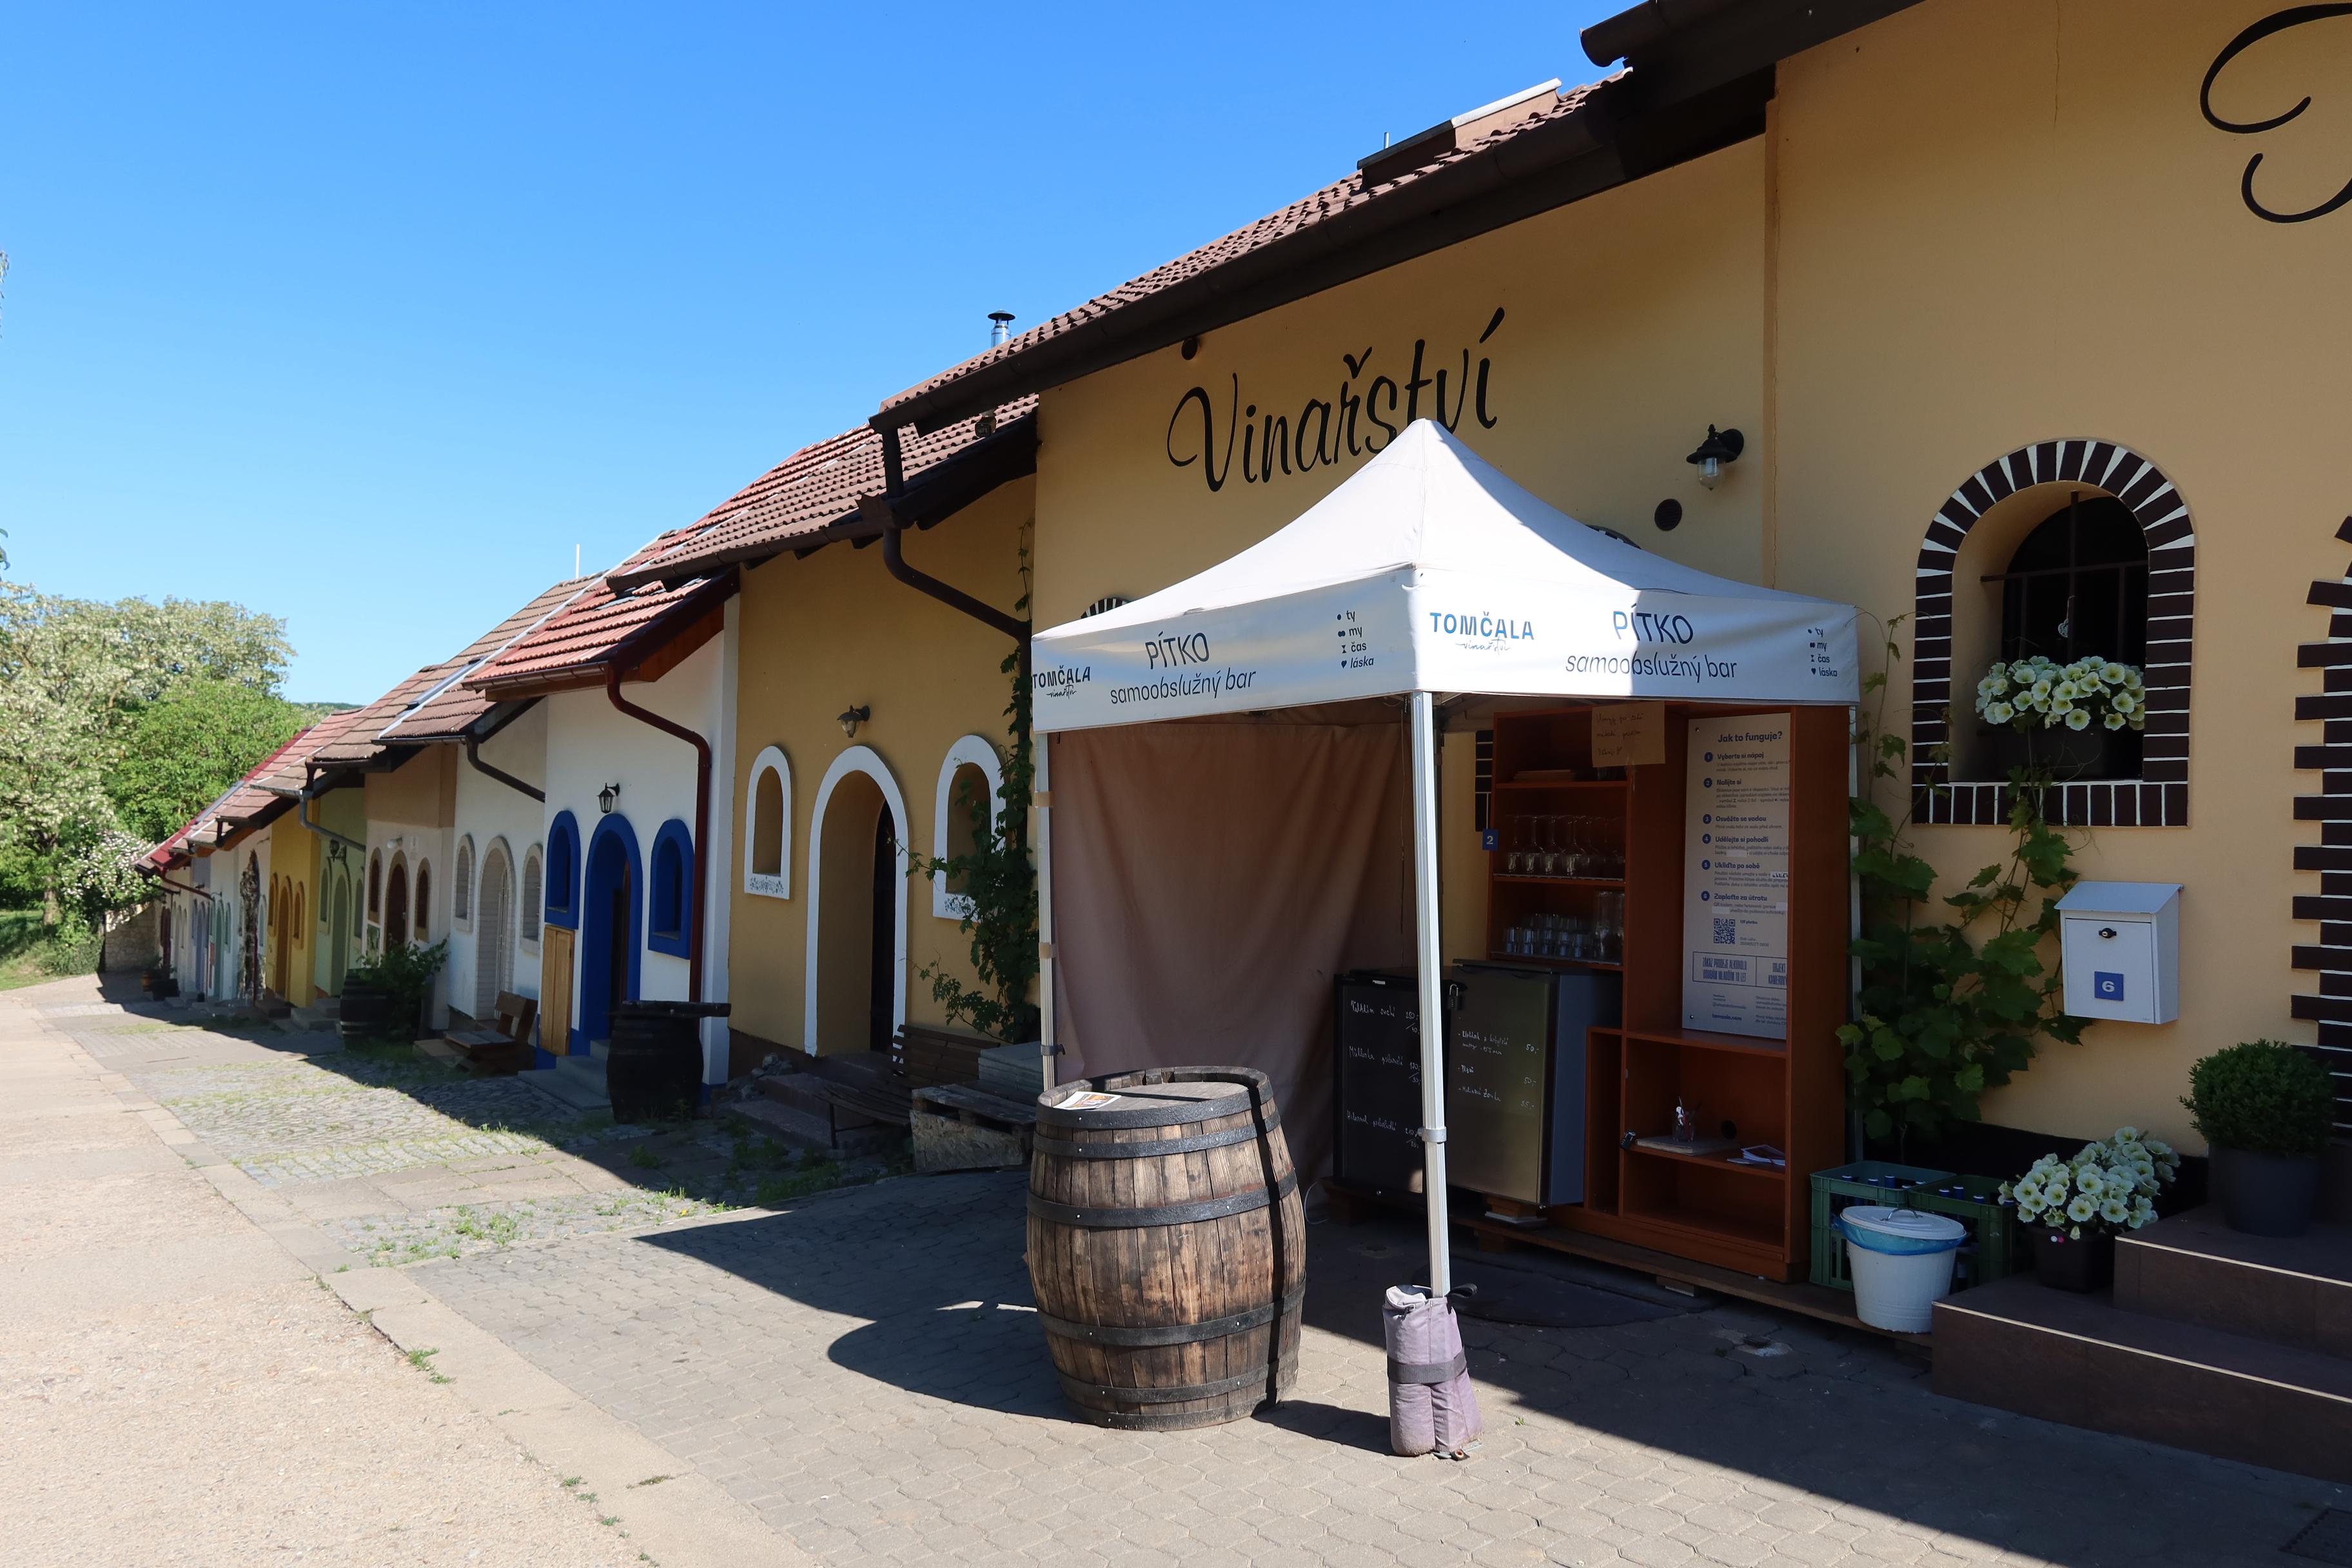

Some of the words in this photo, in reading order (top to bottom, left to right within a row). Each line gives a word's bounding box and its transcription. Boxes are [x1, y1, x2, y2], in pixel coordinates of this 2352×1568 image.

[1167, 307, 1505, 492] Vinařství
[1346, 611, 1355, 622] ty
[1429, 611, 1534, 640] TOMČALA
[1612, 603, 1694, 645] PÍTKO
[1349, 627, 1362, 638] my
[1815, 627, 1823, 638] ty
[1145, 631, 1210, 669] PÍTKO
[1351, 641, 1367, 652] čas
[1817, 642, 1827, 652] my
[1350, 656, 1374, 669] láska
[1818, 654, 1830, 663] čas
[1565, 653, 1701, 683] samoobslužný
[1707, 655, 1737, 678] bar
[1819, 667, 1838, 676] láska
[1033, 665, 1090, 689] TOMČALA
[1110, 671, 1222, 705] samoobslužný
[1226, 667, 1257, 691] bar
[1745, 731, 1783, 742] funguje?
[1487, 835, 1493, 845] 2
[2101, 981, 2115, 992] 6
